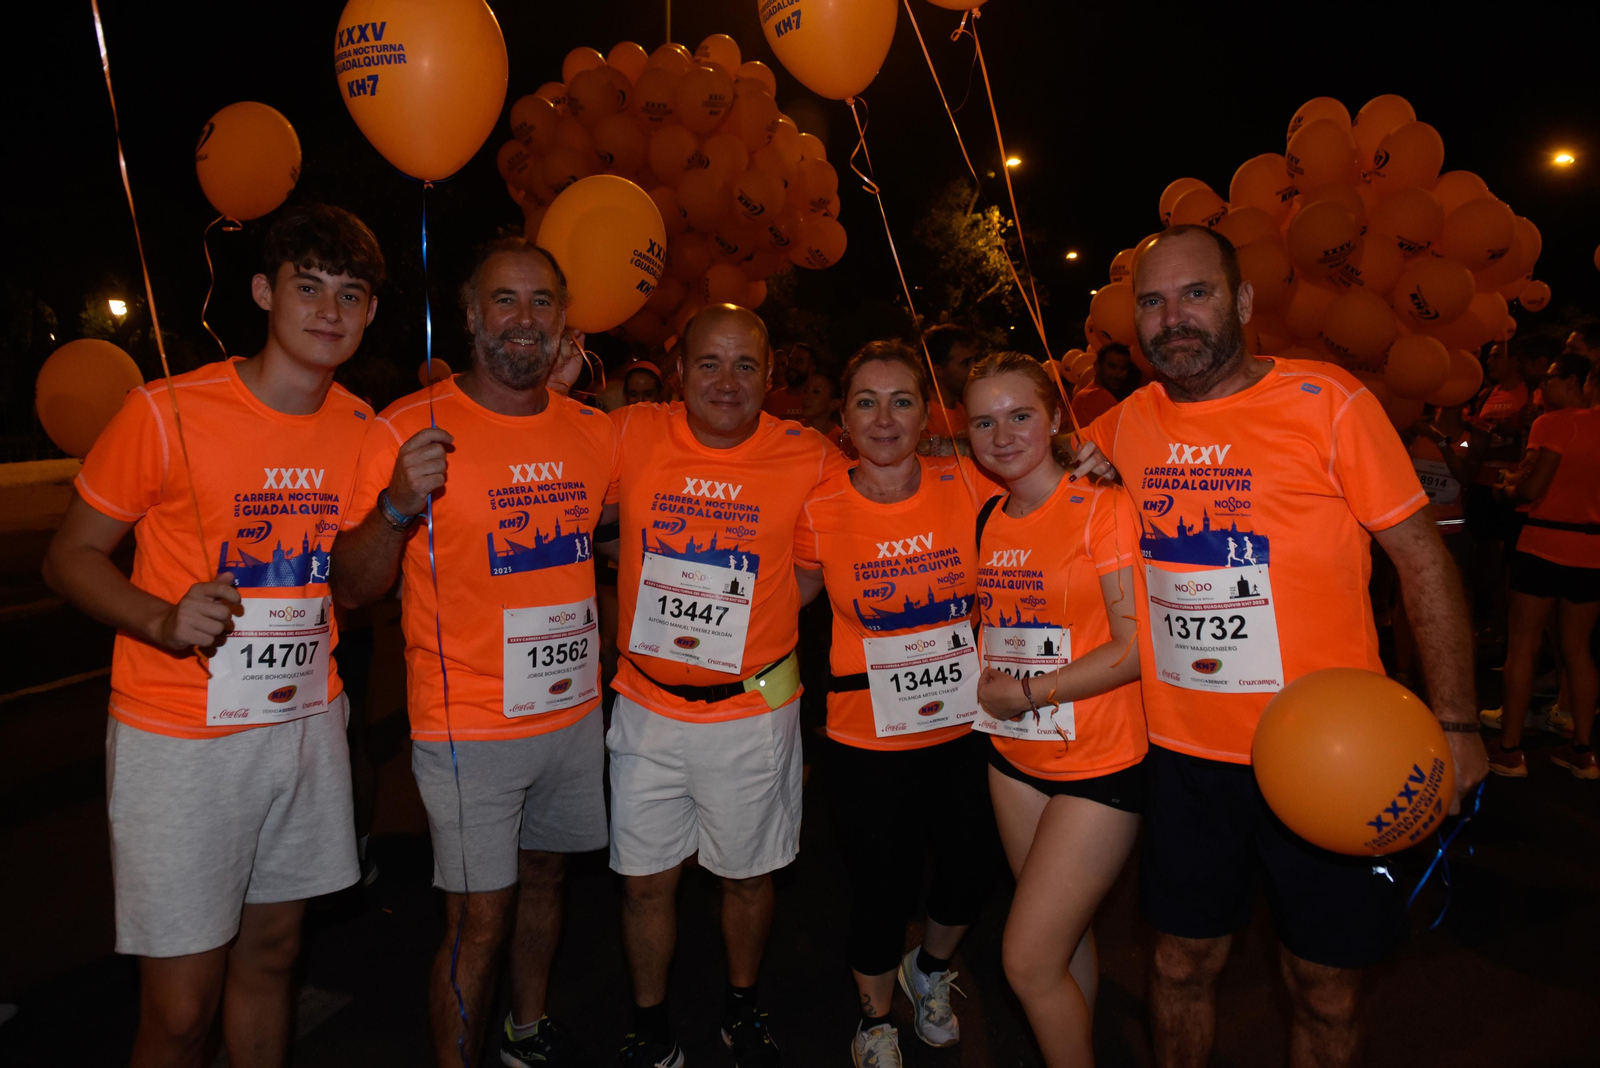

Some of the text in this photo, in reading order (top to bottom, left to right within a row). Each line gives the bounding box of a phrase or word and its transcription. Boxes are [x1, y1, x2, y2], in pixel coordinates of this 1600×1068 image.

[337, 21, 387, 50] XXXV
[353, 43, 405, 56] NOCTURNA
[1166, 443, 1232, 465] XXXV
[263, 467, 325, 490] XXXV
[508, 461, 564, 484] XXXV
[1144, 467, 1253, 477] CARRERA NOCTURNA
[488, 481, 585, 498] CARRERA NOCTURNA
[681, 477, 743, 501] XXXV
[1147, 478, 1251, 492] GUADALQUIVIR
[234, 492, 340, 503] CARRERA NOCTURNA
[498, 490, 587, 509] GUADALQUIVIR
[654, 493, 760, 513] CARRERA NOCTURNA
[242, 503, 339, 516] GUADALQUIVIR
[658, 502, 760, 524] GUADALQUIVIR
[876, 532, 933, 559] XXXV
[853, 546, 959, 571] CARRERA NOCTURNA
[862, 556, 962, 580] GUADALQUIVIR
[986, 549, 1032, 567] XXXV
[493, 565, 513, 575] 2023
[1001, 568, 1044, 578] NOCTURNA
[657, 595, 729, 626] 13447
[1203, 601, 1241, 610] GUADALQUIVIR
[648, 617, 669, 627] ALFONSO
[669, 622, 689, 631] MANUEL
[711, 629, 732, 638] ROLDÁN
[1164, 613, 1248, 641] 13732
[240, 641, 319, 669] 14707
[527, 638, 588, 669] 13562
[1190, 644, 1238, 652] MAAGDENBERG
[241, 674, 264, 682] JORGE
[264, 672, 299, 680] BOHORQUEZ
[527, 672, 543, 680] JORGE
[544, 668, 572, 677] BOHORQUEZ
[890, 662, 962, 694] 13445
[1238, 679, 1277, 687] Cruzcampo
[898, 692, 922, 703] YOLANDA
[938, 686, 959, 696] CHAVES
[1367, 763, 1426, 833] XXXV
